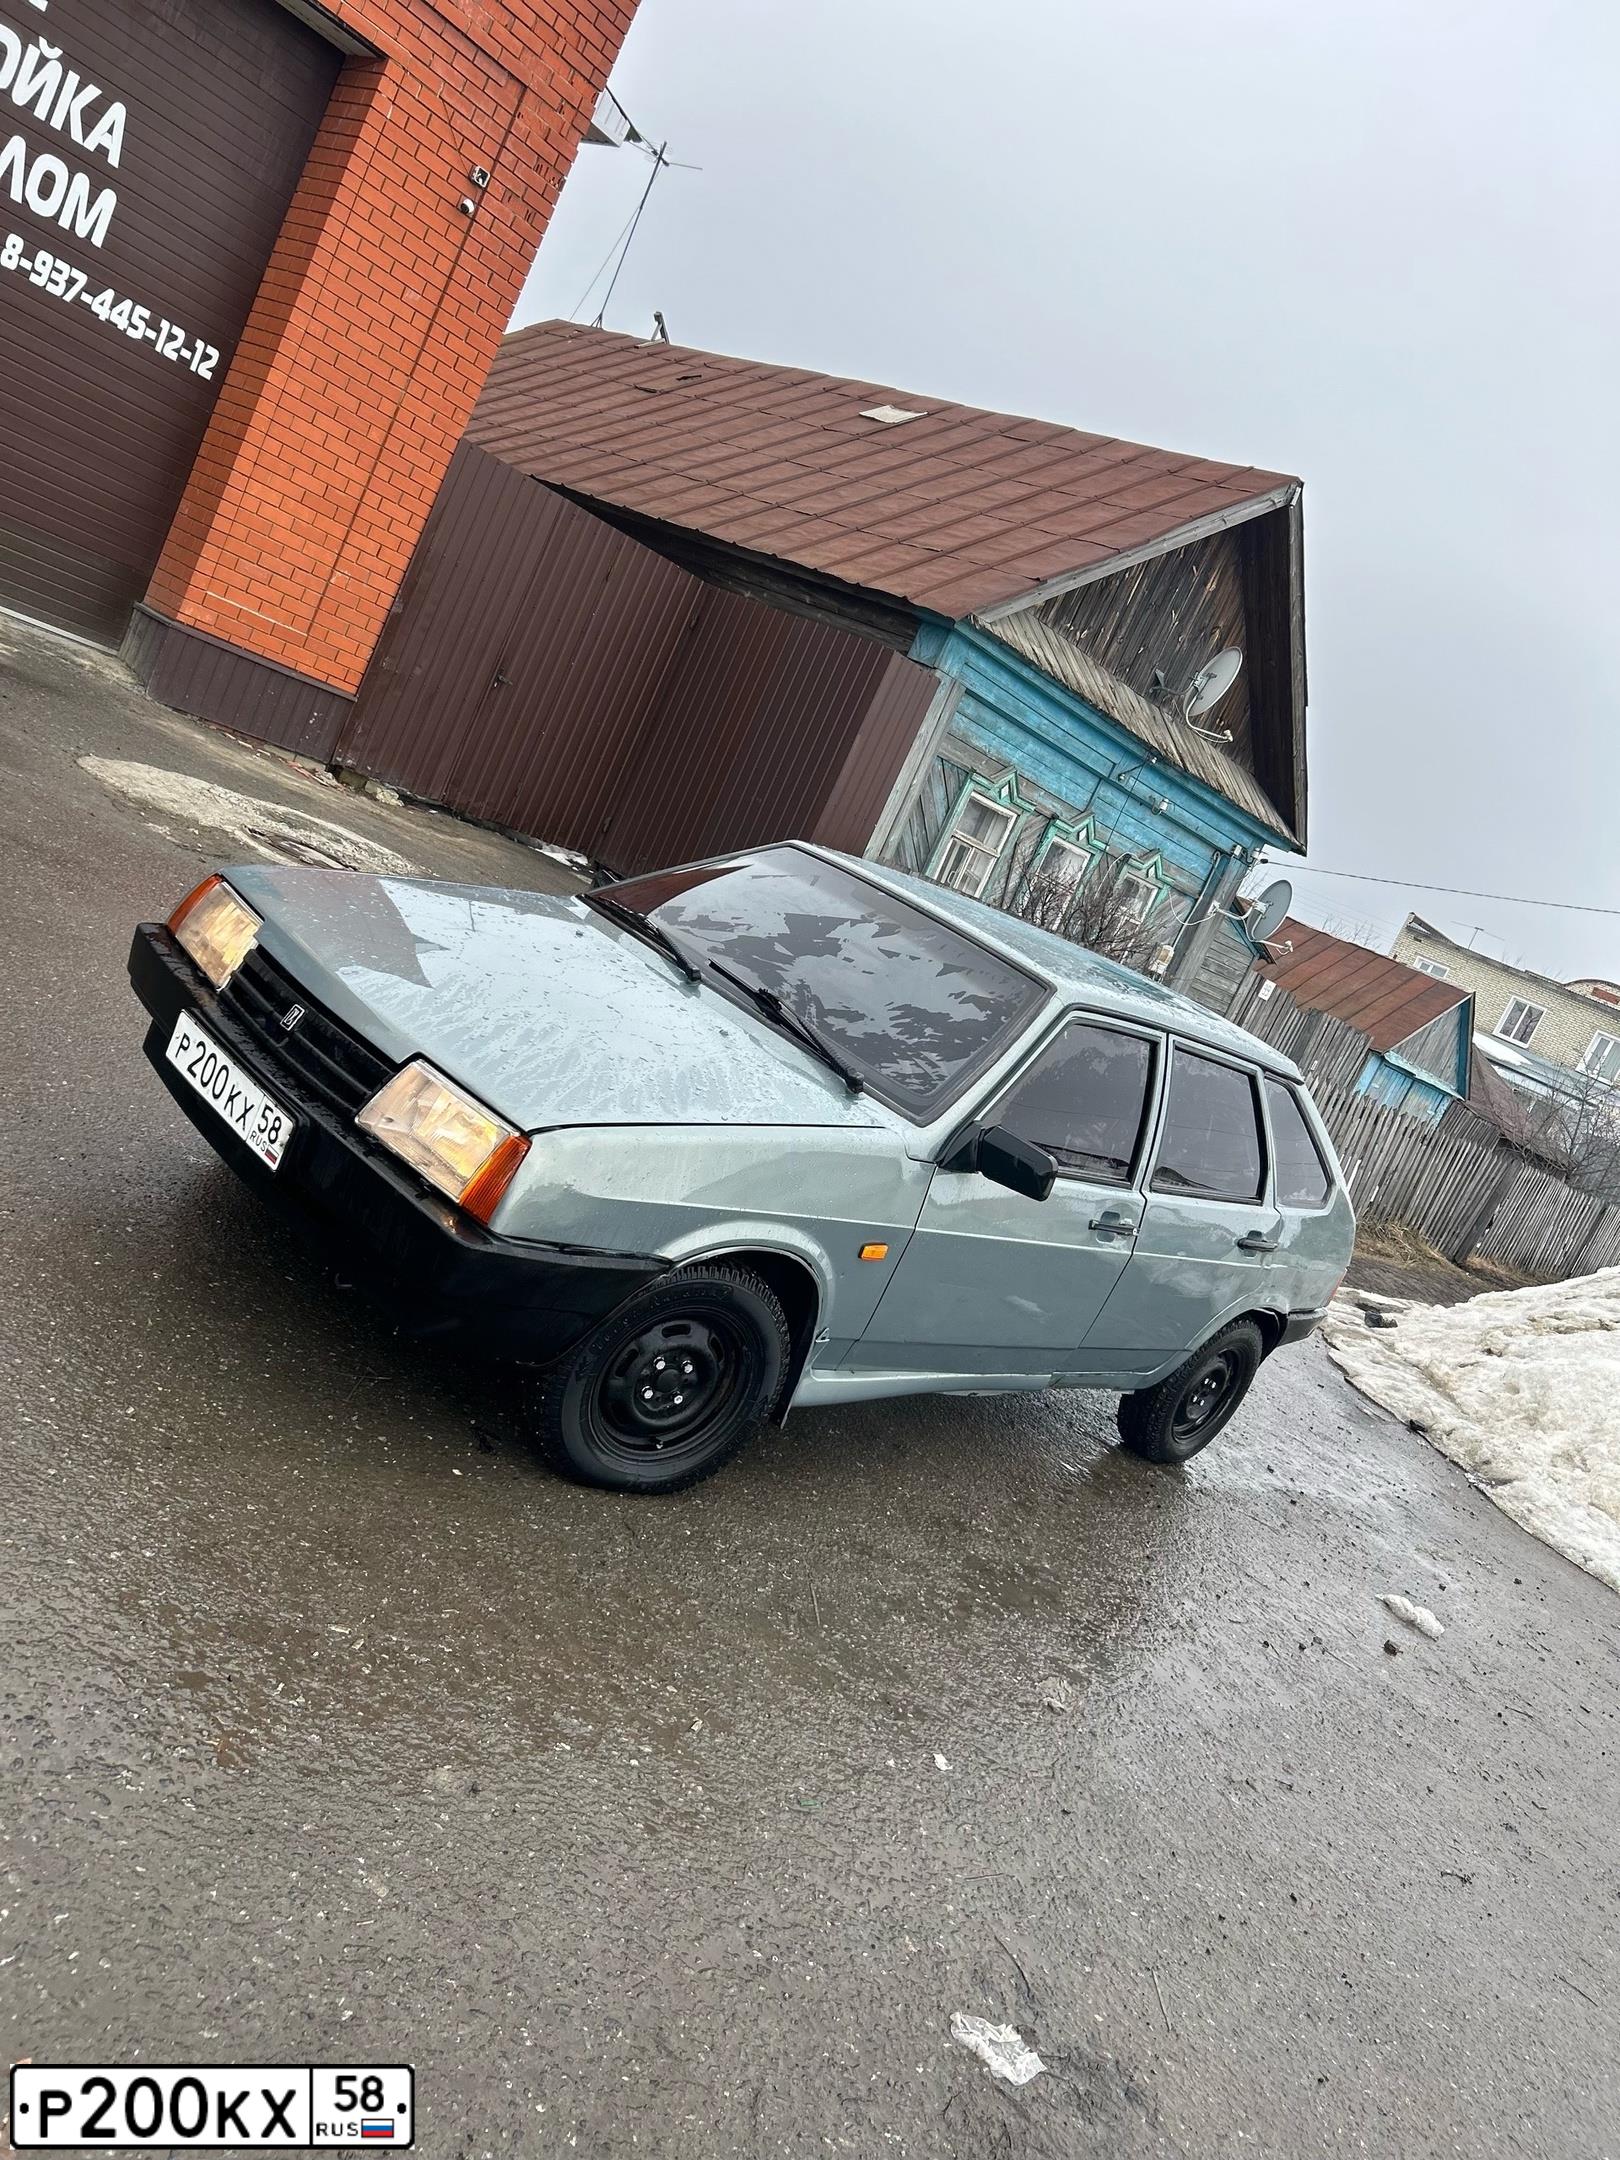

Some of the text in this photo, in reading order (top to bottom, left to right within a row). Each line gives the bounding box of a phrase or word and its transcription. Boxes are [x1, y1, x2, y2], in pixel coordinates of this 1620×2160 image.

[0, 233, 220, 380] 8-937-445-12-12
[174, 1032, 282, 1145] Р200КХ 58
[249, 1131, 267, 1152] RUS
